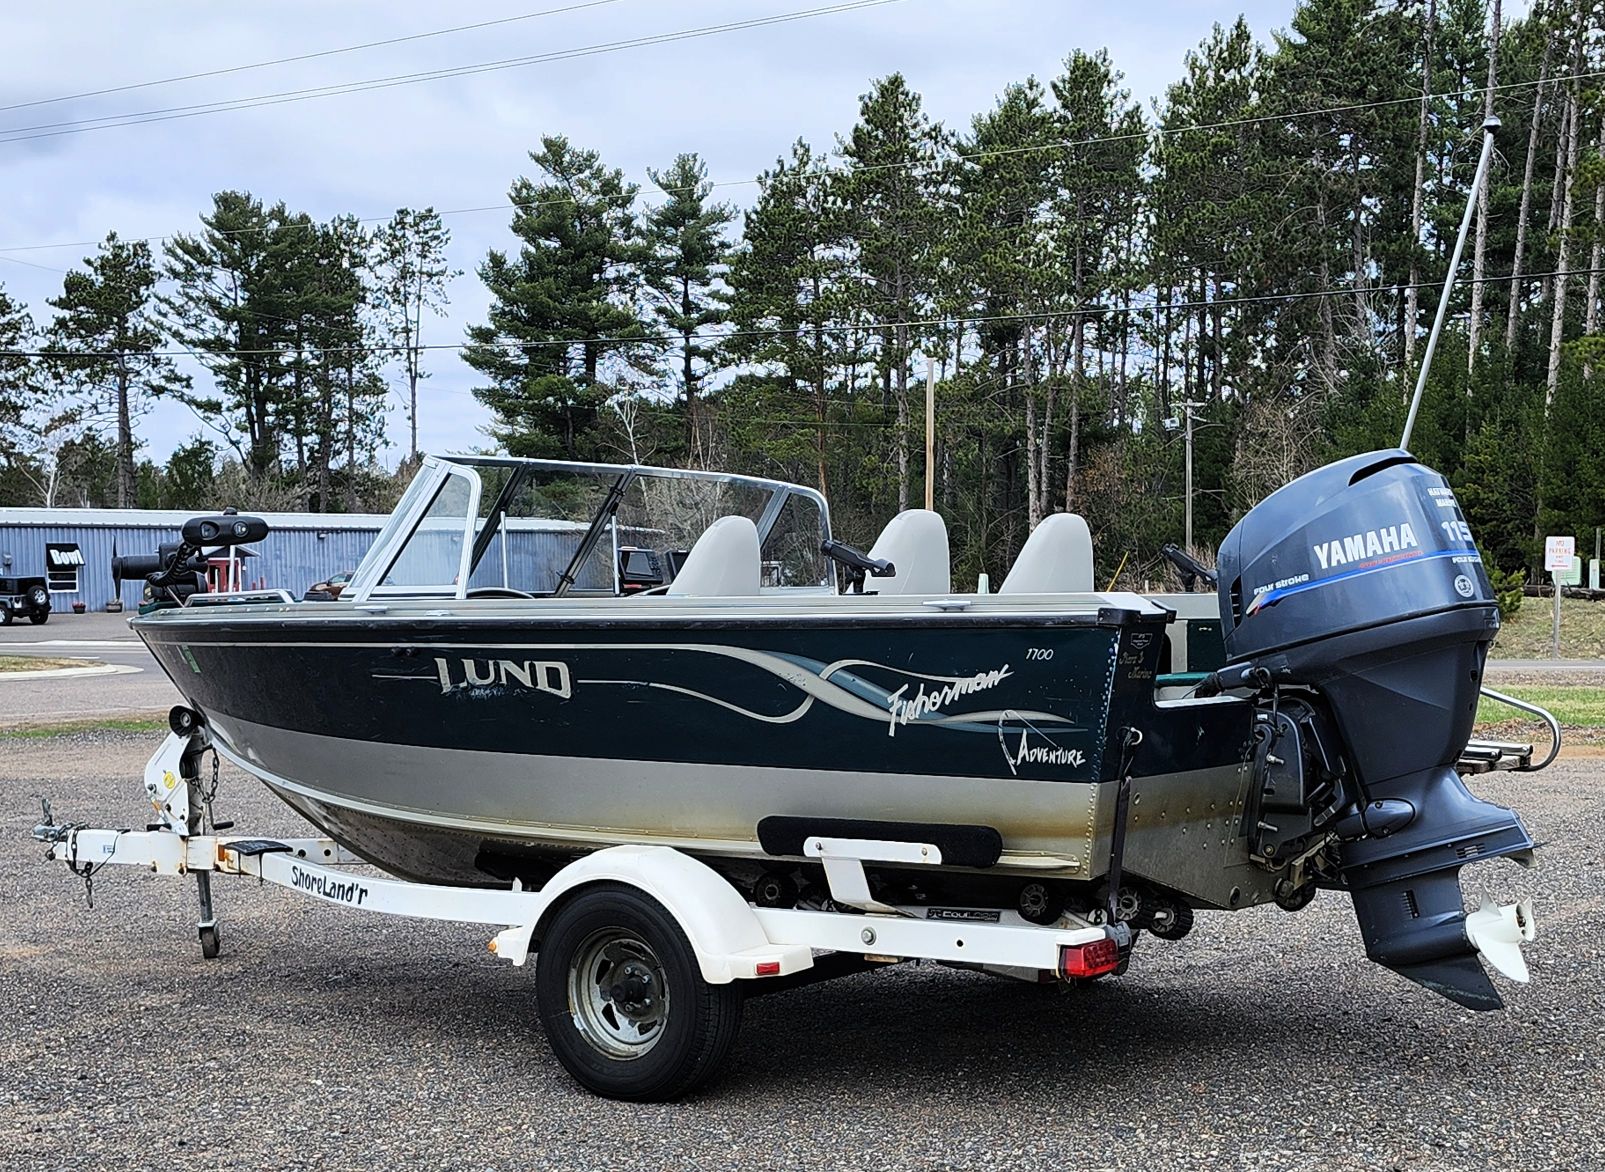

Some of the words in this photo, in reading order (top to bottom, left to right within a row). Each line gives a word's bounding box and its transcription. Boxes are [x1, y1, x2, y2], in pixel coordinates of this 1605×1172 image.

[1313, 522, 1419, 570] YAMAHA
[1441, 521, 1473, 541] 115
[1025, 648, 1054, 661] 1700
[434, 657, 572, 699] LUND
[887, 664, 1014, 737] Fisherman
[291, 865, 369, 905] ShoreLand'r
